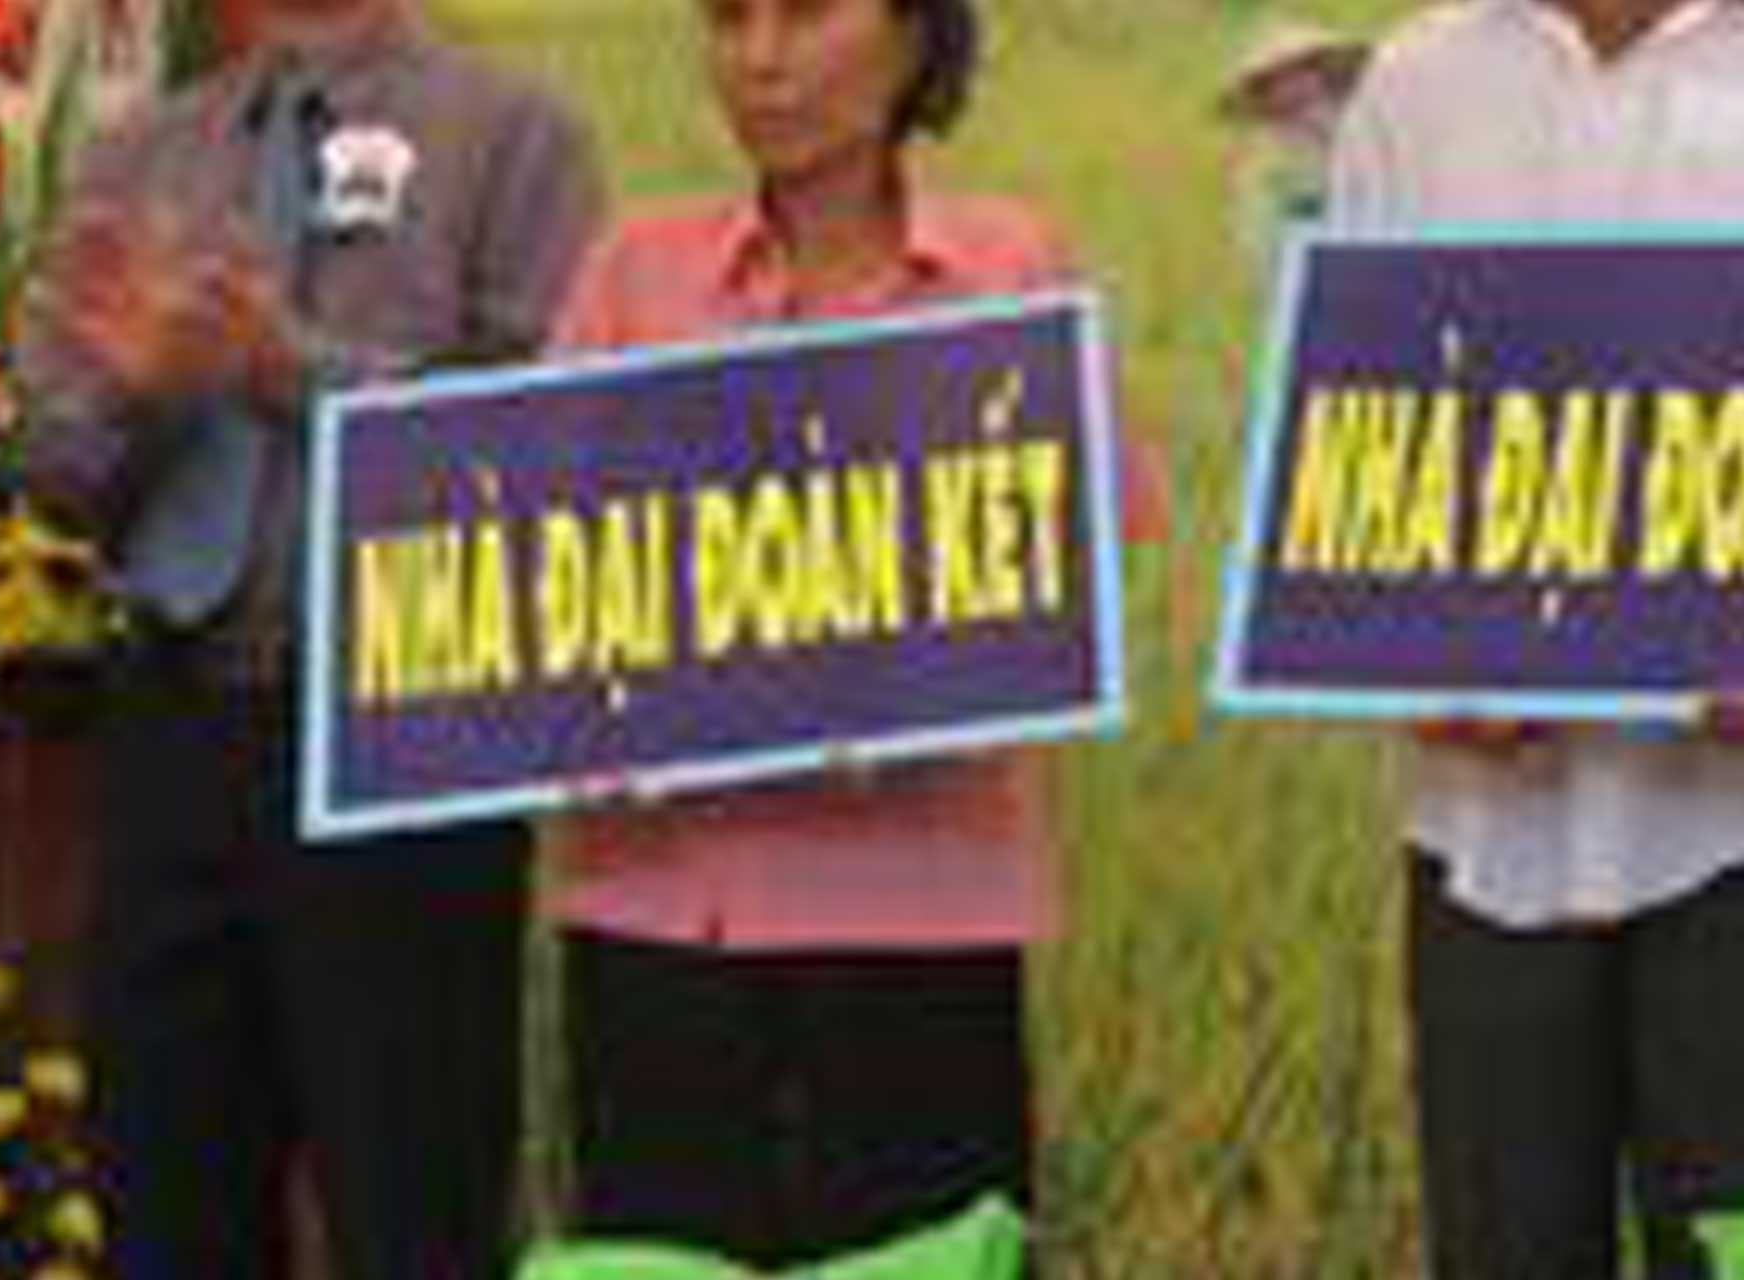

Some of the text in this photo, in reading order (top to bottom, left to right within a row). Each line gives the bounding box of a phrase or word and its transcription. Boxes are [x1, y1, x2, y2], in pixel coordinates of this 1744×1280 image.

[352, 365, 1064, 713] NHÀ ĐẠI ĐOÀN KẾT
[1280, 323, 1462, 576] NHÀ
[1474, 388, 1632, 624] ĐẠI
